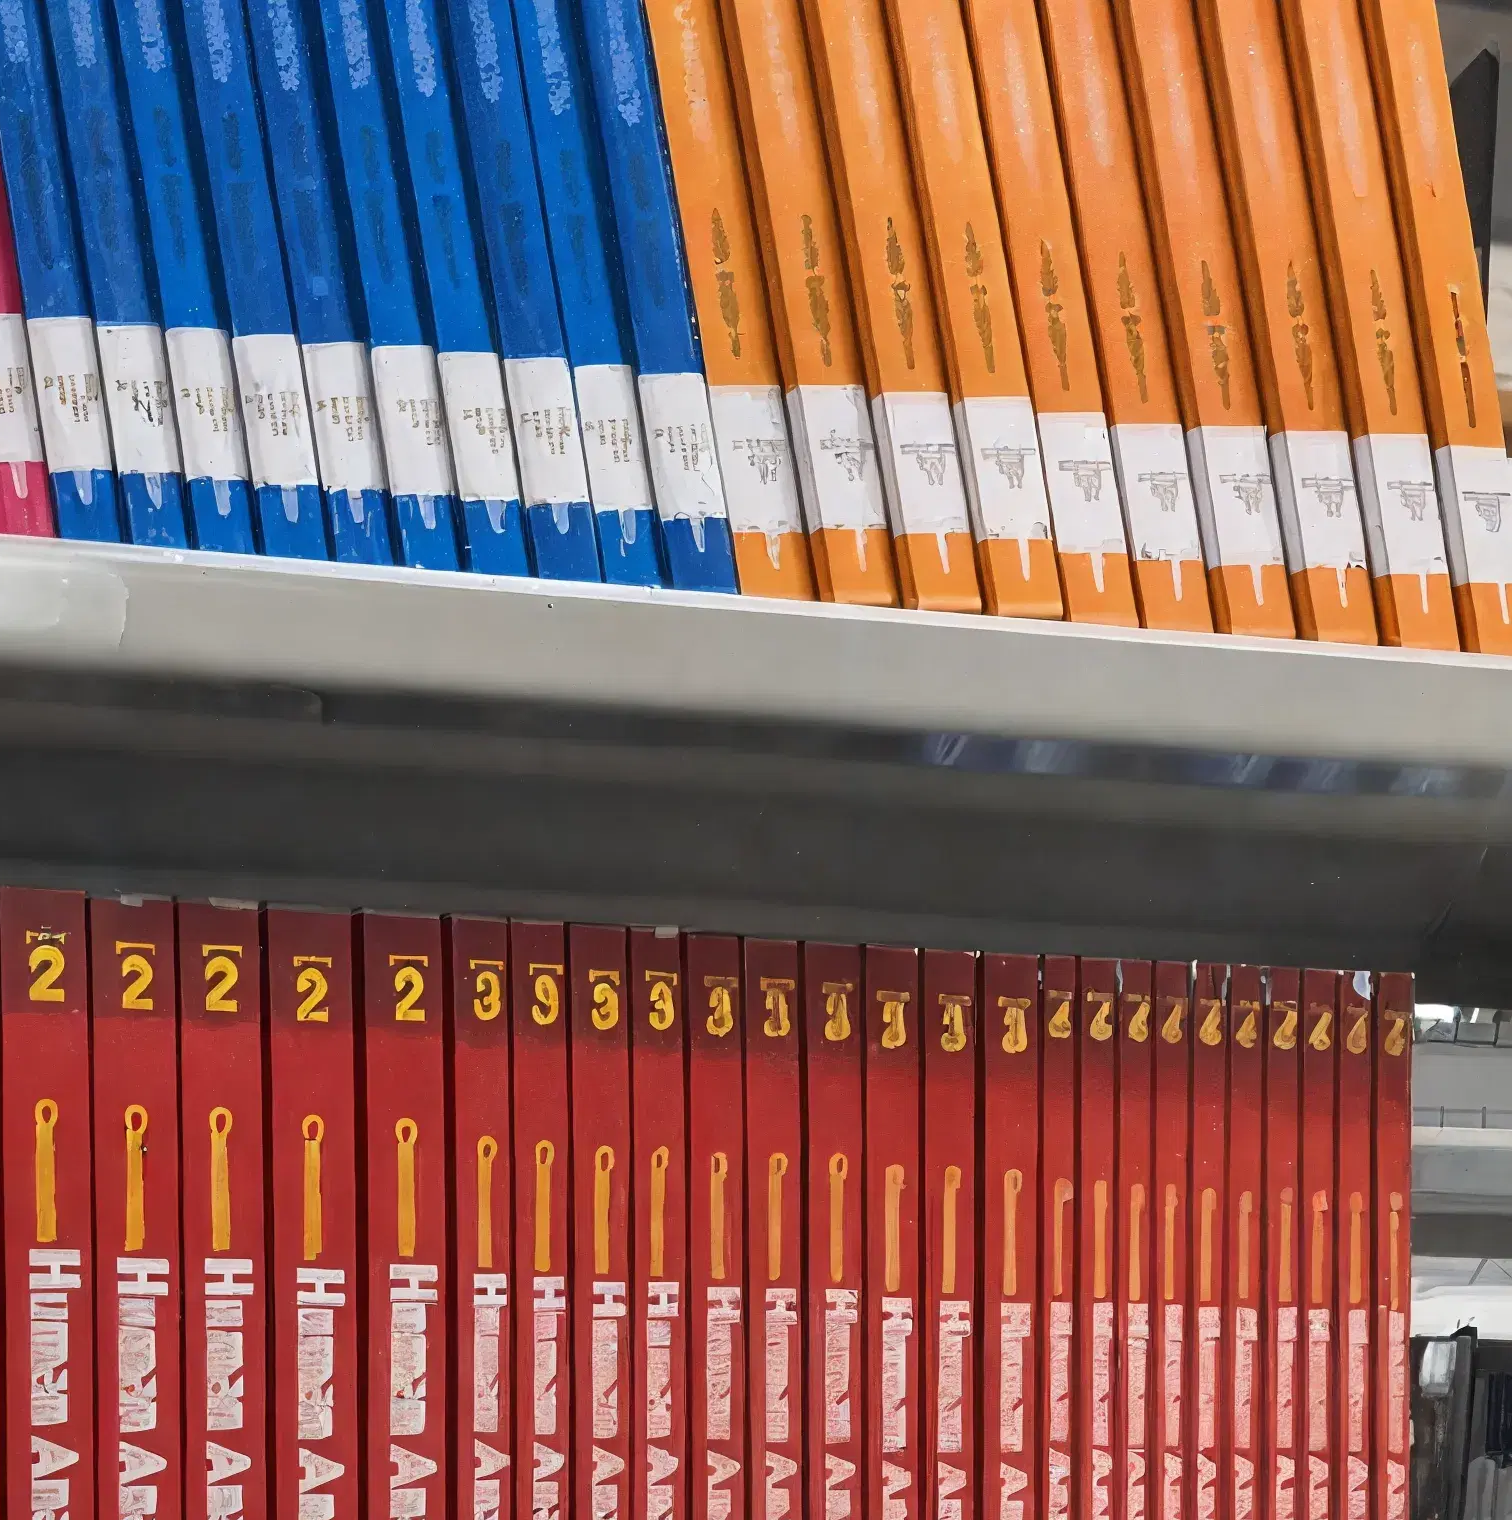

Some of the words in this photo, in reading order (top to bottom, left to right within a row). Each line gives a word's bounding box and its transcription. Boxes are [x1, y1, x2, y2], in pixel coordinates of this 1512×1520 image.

[29, 945, 65, 1001] 2
[121, 954, 154, 1010] 2
[205, 956, 238, 1012] 2
[296, 967, 329, 1022] 2
[395, 966, 426, 1021] 2
[28, 1248, 83, 1426] Human
